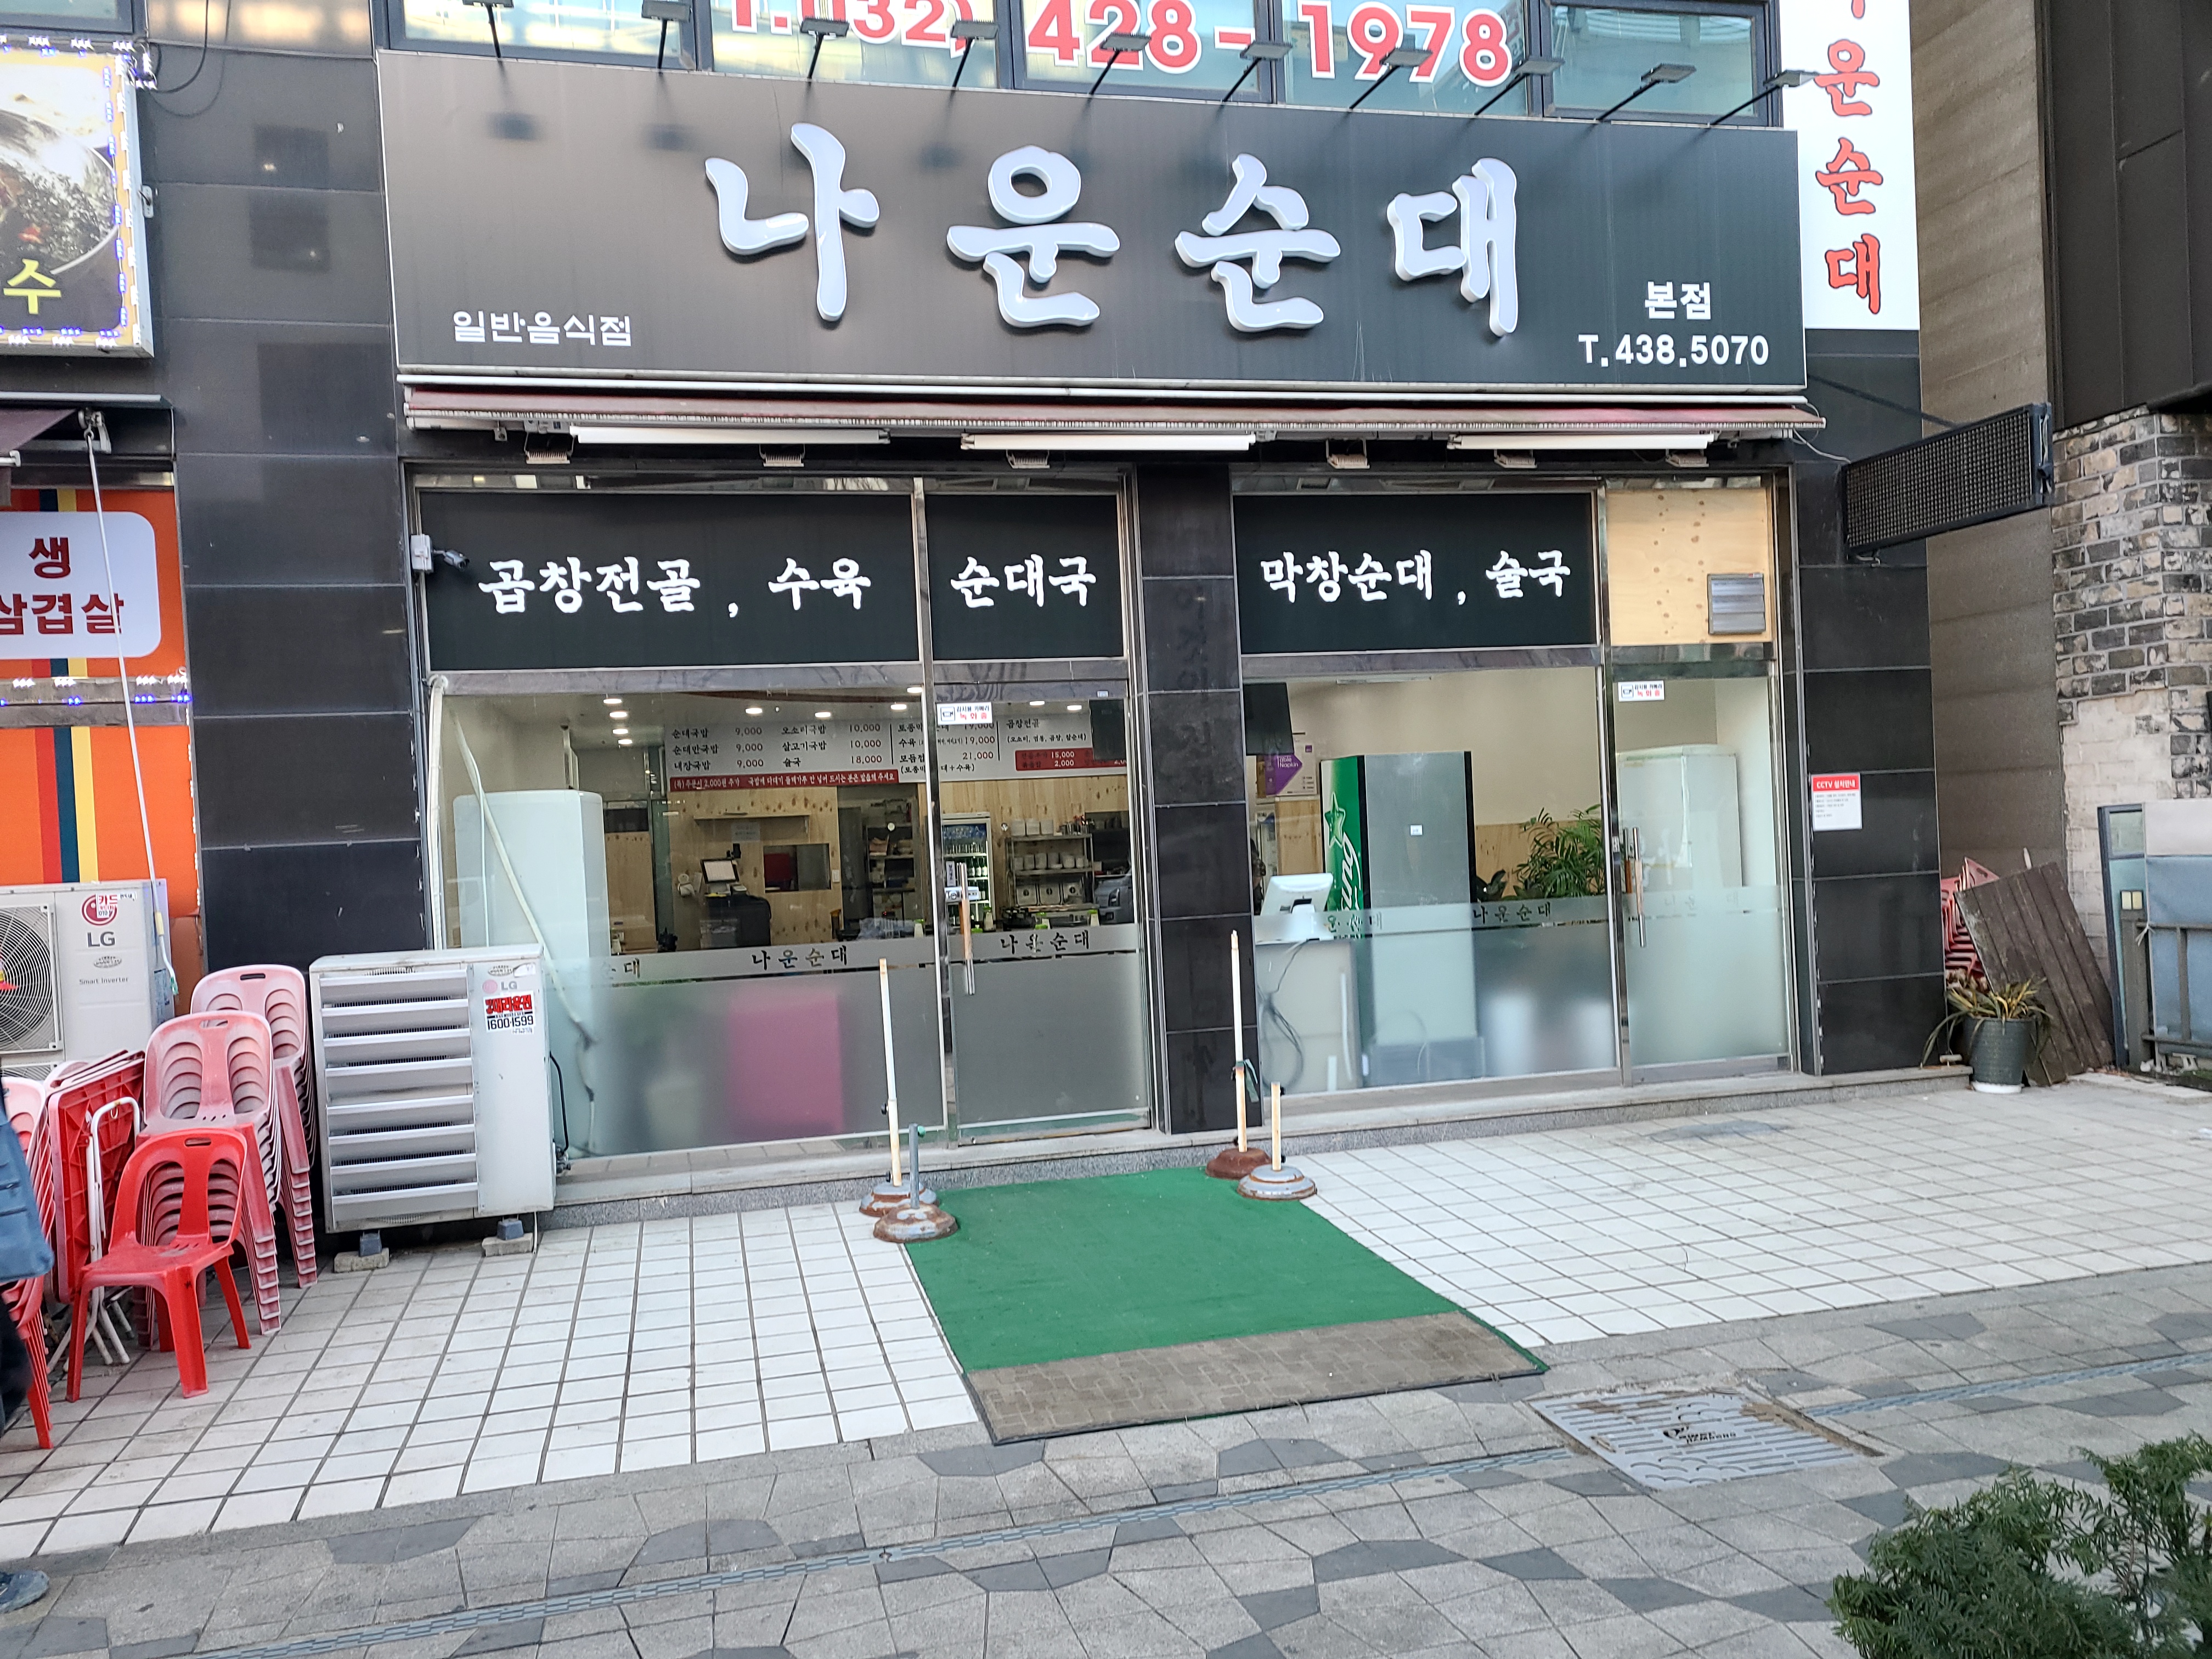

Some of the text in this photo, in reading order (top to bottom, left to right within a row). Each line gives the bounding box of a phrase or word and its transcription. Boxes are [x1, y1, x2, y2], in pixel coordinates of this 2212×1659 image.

[1813, 0, 1884, 314] 운순대
[704, 122, 1519, 336] 나운순대
[1645, 281, 1712, 321] 본점
[453, 310, 632, 347] 일반음식점
[1578, 334, 1769, 368] T.438.5070
[29, 536, 72, 580] 생
[478, 556, 701, 614] 곱창전골
[768, 557, 871, 611] 수육
[950, 554, 1097, 608] 순대국
[1261, 549, 1433, 603] 막창순대
[1485, 549, 1571, 599] 술국
[1816, 781, 1833, 789] CCTV
[1472, 901, 1551, 924] 나운순대
[87, 931, 116, 948] LG
[1000, 930, 1090, 954] 나운순대
[751, 945, 847, 971] 나운순대
[101, 976, 129, 984] Inverter
[501, 981, 518, 991] LG
